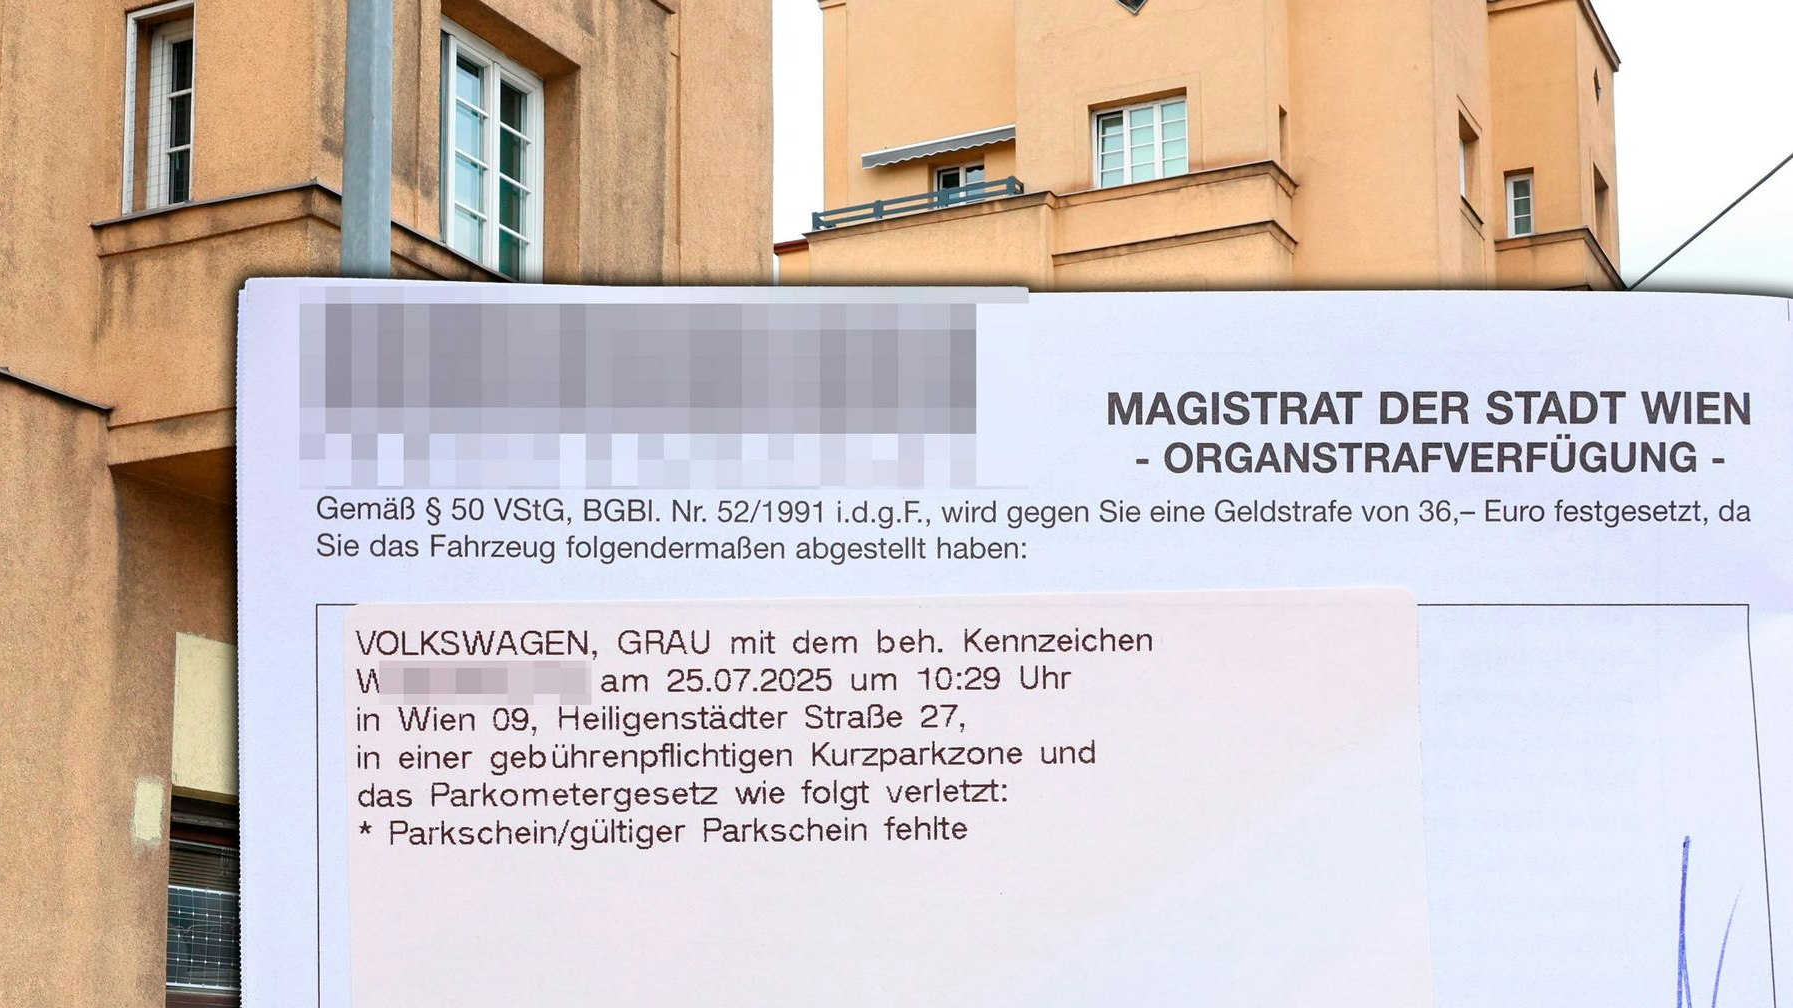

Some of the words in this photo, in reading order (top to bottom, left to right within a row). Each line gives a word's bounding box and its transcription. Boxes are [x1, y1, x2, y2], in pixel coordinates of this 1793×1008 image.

[1107, 390, 1363, 426] MAGISTRAT
[1379, 390, 1469, 425] DER
[1485, 390, 1627, 426] STADT
[1640, 391, 1751, 426] WIEN
[1164, 433, 1697, 474] ORGANSTRAFVERFÜGUNG
[316, 495, 415, 522] Gemäß
[426, 497, 441, 527] §
[451, 497, 485, 522] 50
[493, 497, 572, 526] VStG,
[672, 499, 707, 523] Nr.
[717, 499, 822, 524] 52/1991
[837, 500, 931, 530] i.d.g.F.,
[941, 500, 997, 523] wird
[1007, 505, 1089, 530] gegen
[1099, 499, 1141, 523] Sie
[1150, 499, 1205, 523] eine
[1214, 499, 1352, 523] Geldstrafe
[1361, 505, 1409, 523] von
[1485, 499, 1545, 523] Euro
[1554, 499, 1708, 528] festgesetzt,
[1718, 499, 1752, 522] da
[316, 532, 360, 557] Sie
[369, 533, 419, 558] das
[430, 534, 555, 565] Fahrzeug
[565, 535, 785, 566] folgendermaßen
[795, 536, 927, 567] abgestellt
[937, 536, 1027, 560] haben:
[355, 630, 598, 661] VOLKSWAGEN,
[618, 629, 710, 655] GRAU
[731, 629, 776, 655] mit
[792, 629, 858, 655] dem
[877, 628, 943, 654] beh.
[964, 627, 1153, 653] Kennzeichen
[600, 674, 649, 693] am
[667, 667, 833, 693] 25.07.2025
[851, 672, 897, 692] um
[917, 666, 1001, 691] 10:29
[1020, 664, 1072, 690] Uhr
[357, 706, 380, 732] in
[397, 706, 475, 732] Wien
[492, 707, 537, 737] 09,
[558, 704, 788, 737] Heiligenstädter
[805, 703, 903, 730] Straße
[920, 704, 965, 733] 27,
[357, 744, 380, 770] in
[398, 744, 473, 770] einer
[490, 742, 793, 776] gebührenpflichtigen
[812, 740, 1023, 773] Kurzparkzone
[1040, 739, 1096, 765] und
[357, 782, 413, 808] das
[431, 780, 718, 814] Parkometergesetz
[734, 779, 786, 805] wie
[800, 779, 870, 811] folgt
[885, 777, 1008, 804] verletzt:
[389, 817, 686, 851] Parkschein/gültiger
[703, 816, 867, 843] Parkschein
[883, 815, 968, 841] fehlte
